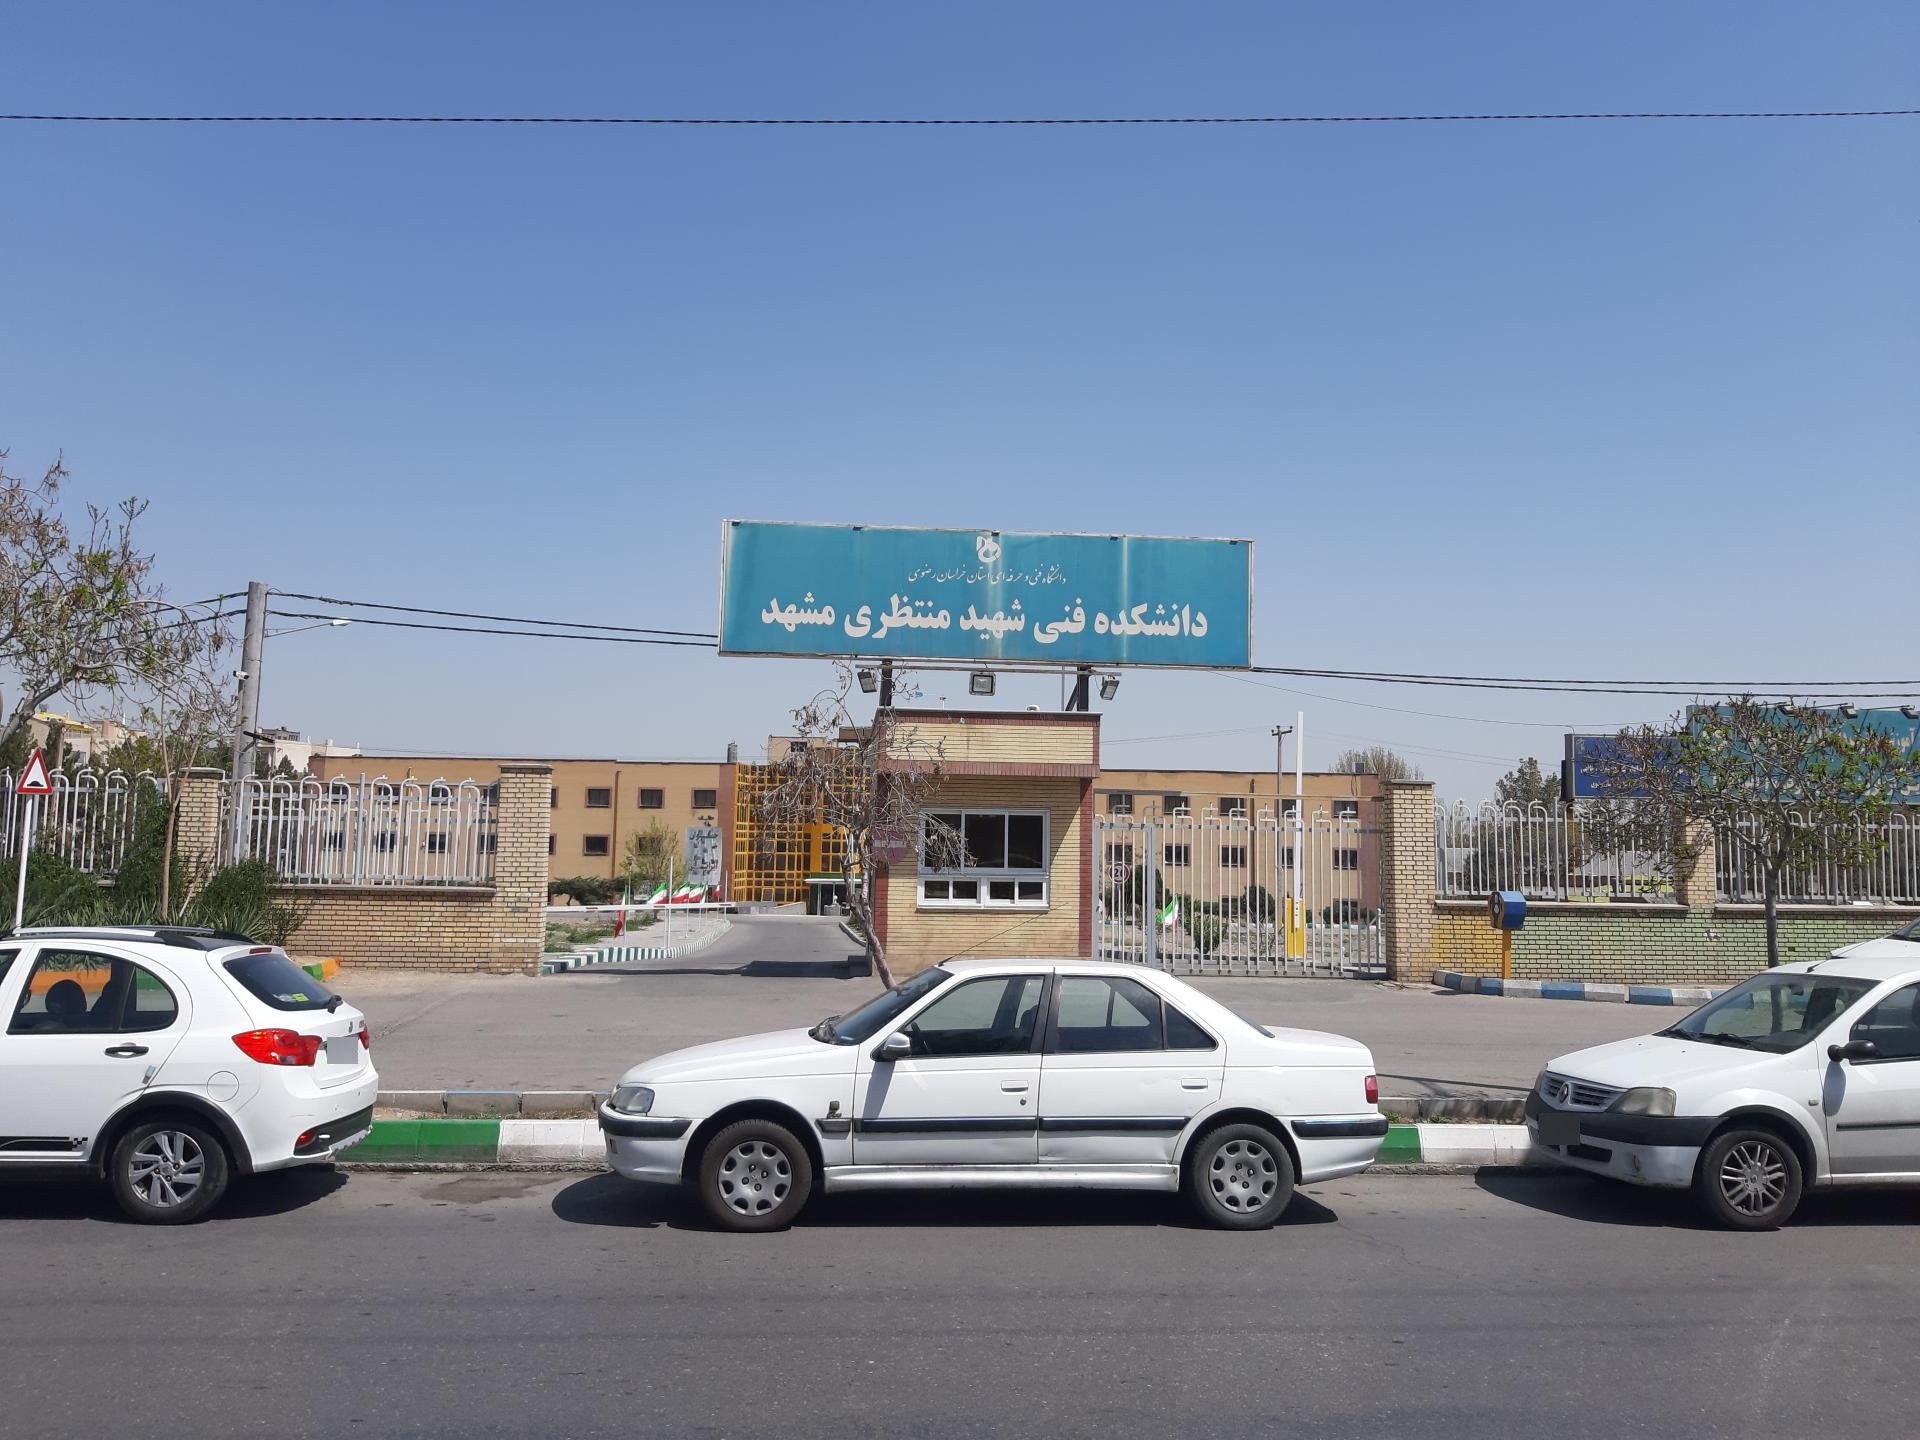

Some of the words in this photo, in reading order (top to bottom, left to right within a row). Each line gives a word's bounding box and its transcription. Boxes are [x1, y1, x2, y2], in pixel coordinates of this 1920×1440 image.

[908, 563, 936, 582] رضوی
[936, 564, 966, 583] خراسان
[966, 566, 990, 584] استان
[1028, 563, 1044, 585] فنی
[1042, 564, 1067, 584] دانشگاه
[761, 591, 836, 633] مشهد
[844, 592, 951, 639] منتظری
[959, 598, 1025, 640] شهید
[1033, 597, 1086, 644] فنی
[1094, 603, 1208, 637] دانشکده
